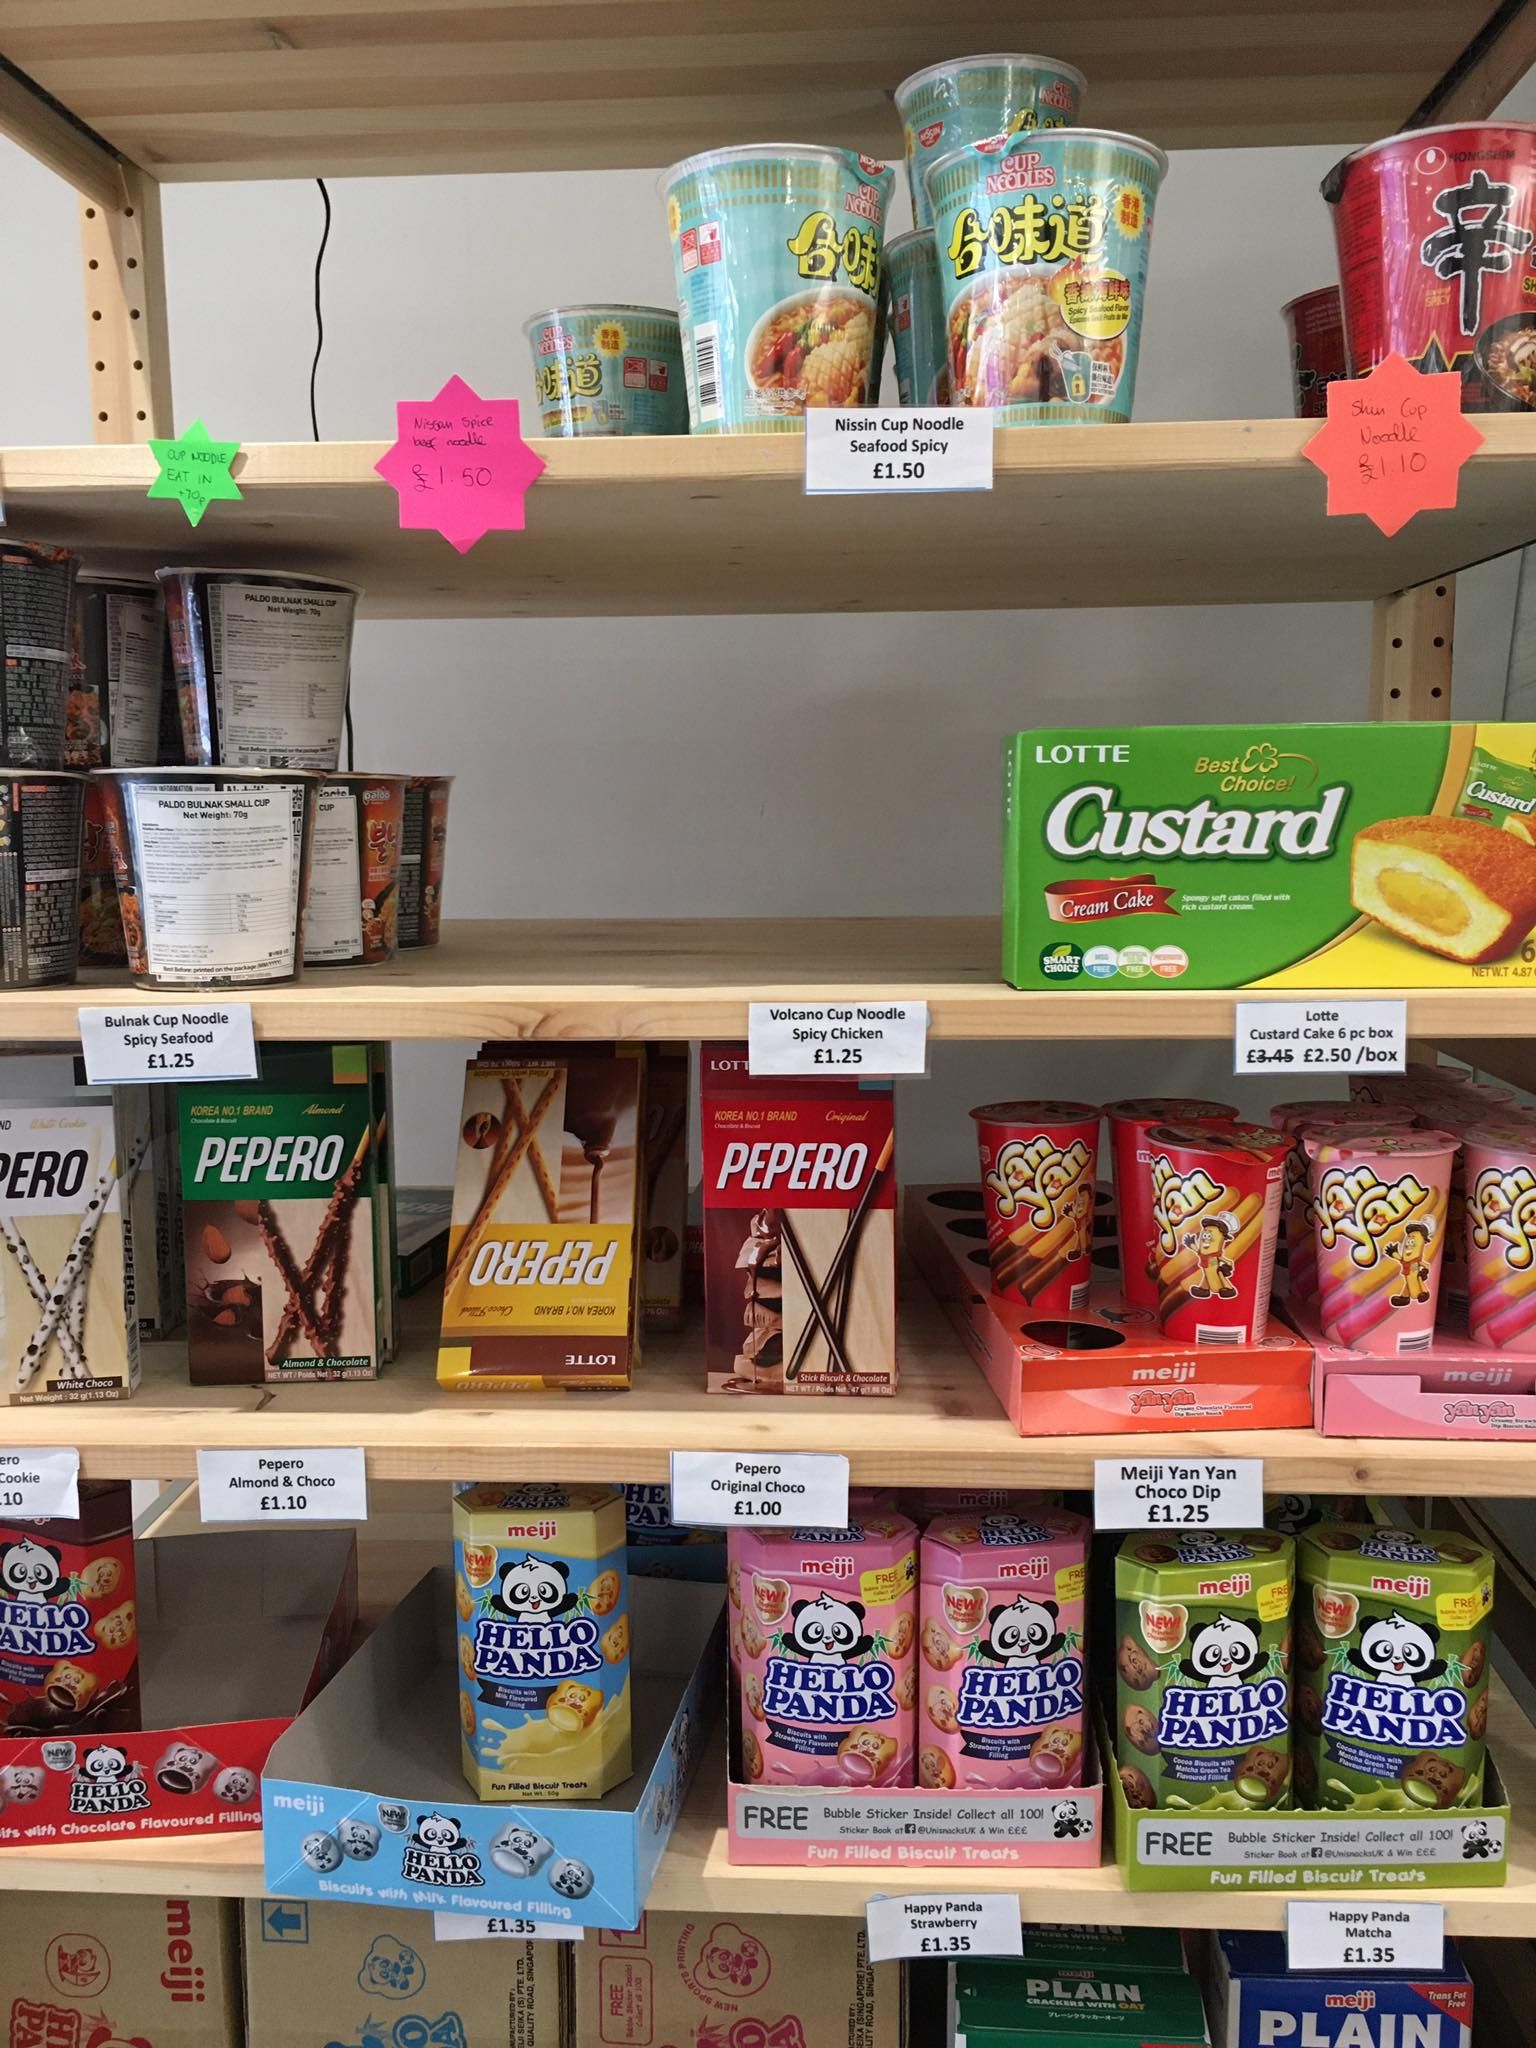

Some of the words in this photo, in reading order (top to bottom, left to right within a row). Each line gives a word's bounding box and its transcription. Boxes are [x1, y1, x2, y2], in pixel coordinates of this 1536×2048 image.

[1000, 152, 1041, 173] CUP
[986, 165, 1056, 196] NOODLES
[946, 193, 1106, 281] 合味道
[1420, 168, 1534, 336] 辛
[836, 419, 877, 432] Nissin
[881, 419, 909, 434] Cup
[913, 417, 965, 430] Noodle
[1360, 423, 1421, 445] Noodle
[850, 439, 908, 453] Seafood
[912, 439, 949, 455] Spicy
[191, 451, 227, 465] NOODLE
[167, 468, 190, 481] EAT
[198, 474, 212, 484] IN
[873, 462, 926, 479] £1.50
[267, 605, 282, 613] Net
[1036, 744, 1130, 763] LOTTE
[1195, 756, 1238, 773] Best
[159, 800, 186, 809] PALDO
[187, 799, 223, 809] BULNAK
[225, 799, 253, 808] SMALL
[254, 798, 271, 807] CUP
[183, 811, 199, 820] Net
[200, 811, 232, 821] Weight:
[233, 810, 249, 820] 70g
[1046, 785, 1347, 856] Custard
[1059, 900, 1110, 918] Cream
[1114, 891, 1154, 910] Cake
[1251, 893, 1273, 902] filled
[1273, 893, 1291, 901] with
[1181, 903, 1197, 911] rich
[104, 1014, 150, 1028] Bulnak
[153, 1014, 179, 1029] Cup
[182, 1011, 229, 1025] Noodle
[769, 1008, 824, 1021] Volcano
[826, 1008, 854, 1022] Cup
[857, 1007, 906, 1020] Noodle
[1305, 1010, 1340, 1022] Lotte
[124, 1034, 158, 1048] Spicy
[161, 1031, 214, 1045] Seafood
[792, 1027, 828, 1042] Spicy
[830, 1027, 883, 1040] Chicken
[147, 1053, 195, 1069] £1.25
[813, 1048, 863, 1064] £1.25
[193, 1134, 345, 1183] PEPERO
[715, 1141, 869, 1190] PEPERO
[565, 1354, 617, 1366] LOTTE
[1131, 1361, 1197, 1382] meiji
[1442, 1366, 1513, 1386] meiji
[57, 1380, 84, 1390] White
[85, 1379, 114, 1389] Choco
[20, 1395, 34, 1403] Net
[34, 1394, 63, 1403] Weight
[69, 1392, 80, 1400] 32
[258, 1459, 304, 1471] Pepero
[735, 1461, 782, 1477] Pepero
[1121, 1465, 1164, 1483] Meiji
[1168, 1466, 1201, 1480] Yan
[1205, 1466, 1237, 1480] Yan
[229, 1476, 279, 1489] Almond
[282, 1476, 293, 1488] &
[296, 1475, 336, 1488] Choco
[710, 1479, 762, 1495] Original
[765, 1481, 806, 1494] Choco
[1135, 1484, 1188, 1499] Choco
[1192, 1485, 1222, 1502] Dip
[260, 1495, 307, 1511] £1.10
[734, 1500, 783, 1517] £1.00
[1147, 1504, 1210, 1523] £1.25
[507, 1521, 558, 1540] meiji
[801, 1557, 854, 1579] meiji
[998, 1557, 1050, 1580] meiji
[1199, 1573, 1252, 1598] meiji
[1371, 1574, 1431, 1599] meiji
[479, 1624, 596, 1651] HELLO
[475, 1649, 601, 1677] PANDA
[768, 1660, 892, 1694] HELLO
[964, 1663, 1082, 1699] HELLO
[764, 1687, 897, 1723] PANDA
[1165, 1682, 1288, 1718] HELLO
[1330, 1675, 1467, 1718] HELLO
[958, 1689, 1083, 1723] PANDA
[1159, 1714, 1289, 1747] PANDA
[1323, 1703, 1468, 1747] PANDA
[1173, 1756, 1192, 1766] Cocoa
[1192, 1757, 1217, 1767] Biscuits
[1217, 1758, 1235, 1767] with
[1175, 1764, 1199, 1774] Matcha
[1199, 1765, 1217, 1774] Green
[1216, 1765, 1231, 1774] Tea
[1175, 1771, 1207, 1781] Flavoured
[1206, 1772, 1229, 1782] Filling
[73, 1782, 147, 1800] HELLO
[70, 1798, 151, 1814] PANDA
[743, 1805, 809, 1831] FREE
[839, 1825, 871, 1836] Sticker
[871, 1826, 893, 1836] Book
[894, 1827, 904, 1835] at
[917, 1825, 977, 1836] @UnisnacksUK
[987, 1825, 1006, 1836] Win
[1145, 1830, 1214, 1857] FREE
[406, 1851, 479, 1871] HELLO
[807, 1845, 839, 1861] Fun
[844, 1845, 892, 1861] Filled
[896, 1845, 958, 1860] Biscuit
[961, 1845, 1020, 1861] Treats
[403, 1866, 484, 1886] PANDA
[1210, 1870, 1243, 1887] Fun
[1249, 1870, 1298, 1886] Filled
[1302, 1870, 1365, 1885] Biscuit
[1368, 1869, 1427, 1884] Treats
[904, 1901, 943, 1917] Happy
[945, 1900, 984, 1914] Panda
[909, 1916, 978, 1930] Strawberry
[1328, 1910, 1369, 1926] Happy
[1371, 1910, 1411, 1924] Panda
[1344, 1926, 1393, 1940] Matcha
[920, 1935, 972, 1953] £1.35
[526, 1940, 536, 1983] SINGAPOR
[1342, 1946, 1396, 1964] £1.35
[1025, 1978, 1143, 2002] PLAIN
[1427, 1990, 1453, 2001] Trans
[1452, 1991, 1467, 2000] Fat
[609, 1983, 625, 2017] FREE
[1025, 1998, 1086, 2009] CRACKERS
[1086, 2000, 1118, 2010] WITH
[1117, 2001, 1147, 2011] OAT
[1325, 1990, 1377, 2012] meiji
[526, 2017, 536, 2048] QUALITY
